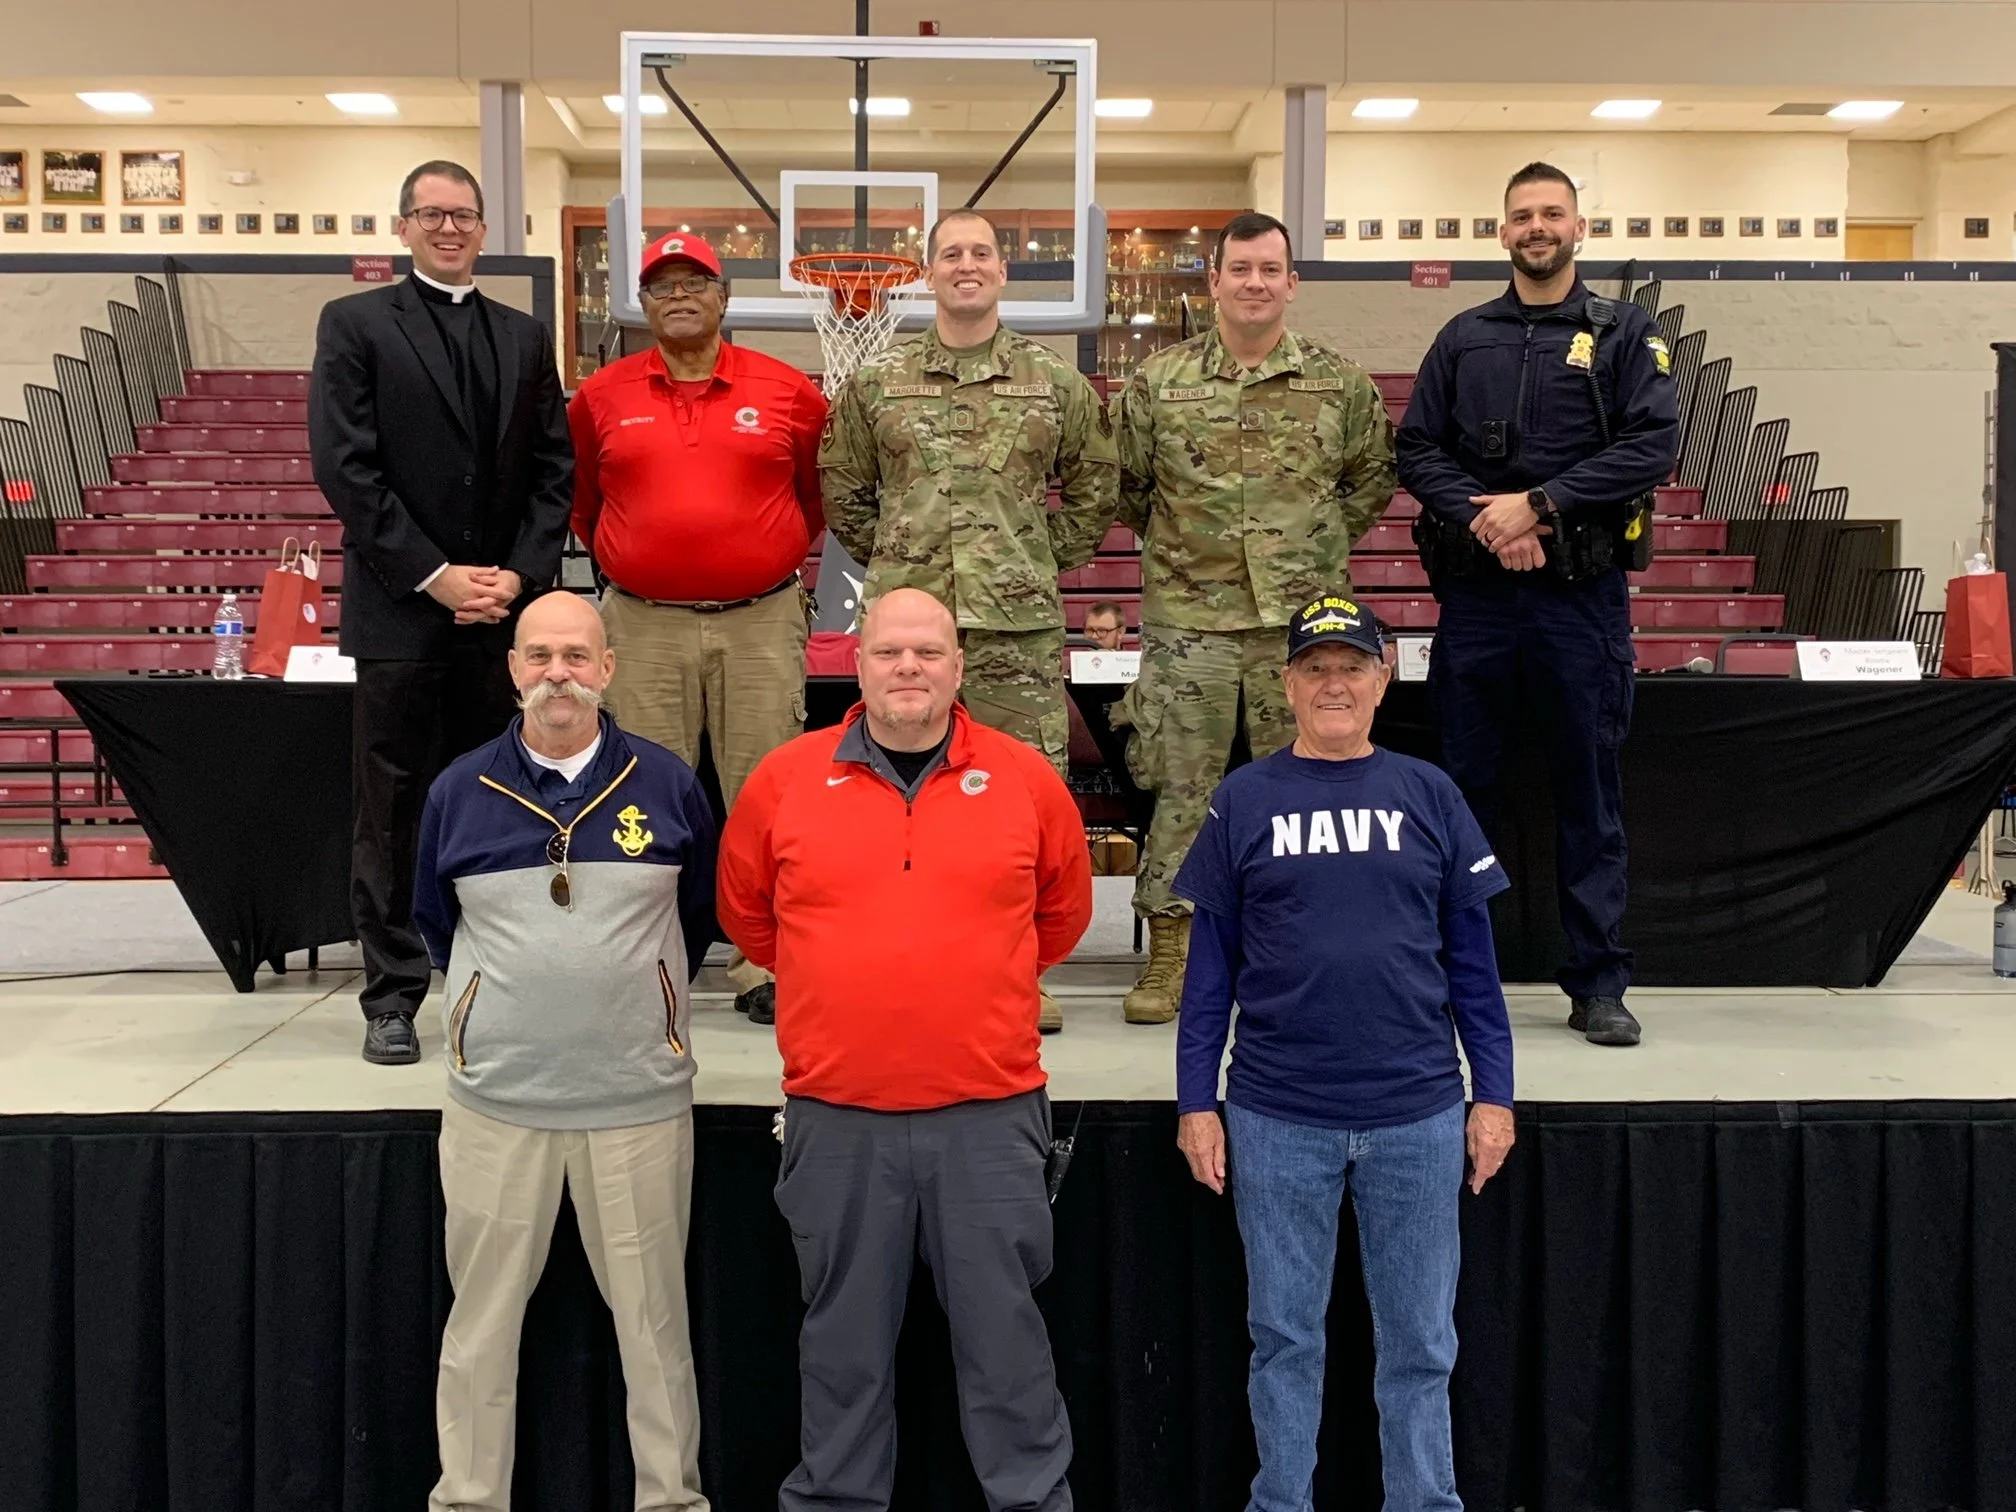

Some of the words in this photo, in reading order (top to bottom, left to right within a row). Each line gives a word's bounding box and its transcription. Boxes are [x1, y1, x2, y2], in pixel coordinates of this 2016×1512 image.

[354, 259, 391, 269] Section
[1414, 264, 1449, 274] Section
[363, 271, 381, 280] 403
[1422, 277, 1438, 286] 401
[1290, 379, 1302, 389] US
[1304, 380, 1316, 390] AIR
[1317, 378, 1341, 389] FORCE
[889, 386, 937, 396] MARQUETTE
[996, 385, 1008, 394] US
[1010, 386, 1022, 395] AIR
[1023, 385, 1048, 395] FORCE
[1168, 389, 1206, 400] WAGENER
[1302, 601, 1321, 620] USS
[1323, 597, 1359, 616] BOXER
[1312, 622, 1346, 634] LPH-4
[1855, 665, 1903, 676] Wagener
[1271, 809, 1404, 857] NAVY
